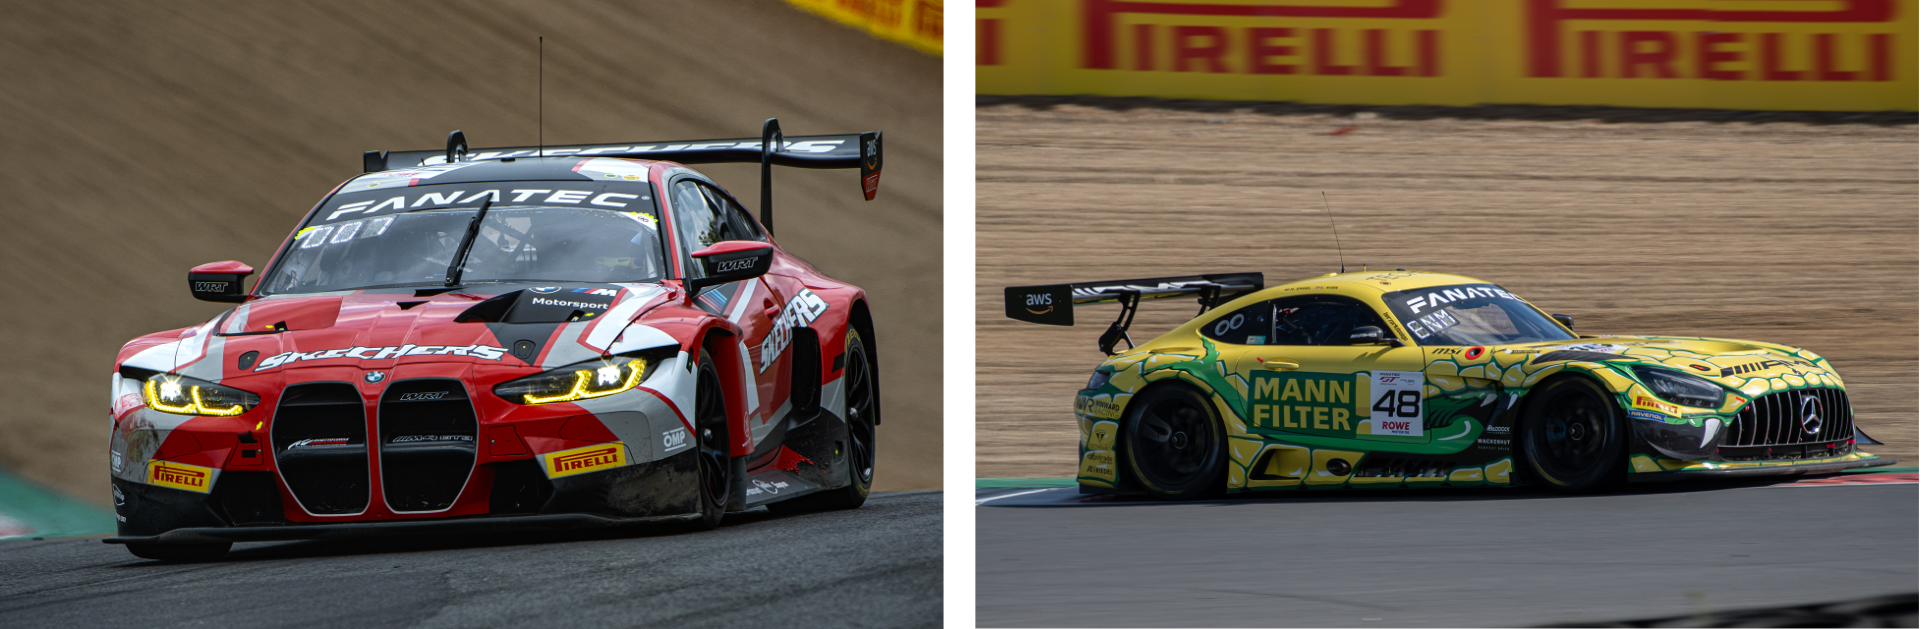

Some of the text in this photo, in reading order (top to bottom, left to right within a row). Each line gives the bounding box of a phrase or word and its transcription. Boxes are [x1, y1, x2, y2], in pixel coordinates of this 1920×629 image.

[326, 188, 639, 220] FANATEC
[717, 257, 758, 273] WRT
[195, 281, 228, 293] WRT
[532, 297, 609, 310] Motorsport
[1026, 293, 1052, 306] aws
[758, 287, 830, 376] SKECHERS
[254, 343, 510, 374] SKECHERS
[400, 391, 449, 401] WRT
[1253, 376, 1350, 404] MANN
[1095, 400, 1120, 412] WINWARD
[1372, 389, 1421, 418] 48
[1636, 396, 1679, 415] PIRELLI
[1094, 407, 1120, 419] RACING
[1253, 404, 1351, 431] FILTER
[1630, 411, 1663, 421] RAVENOL
[1382, 421, 1410, 430] ROWE
[663, 430, 687, 448] OMP
[554, 447, 618, 473] PIRELLI
[154, 465, 205, 487] PIRELLI
